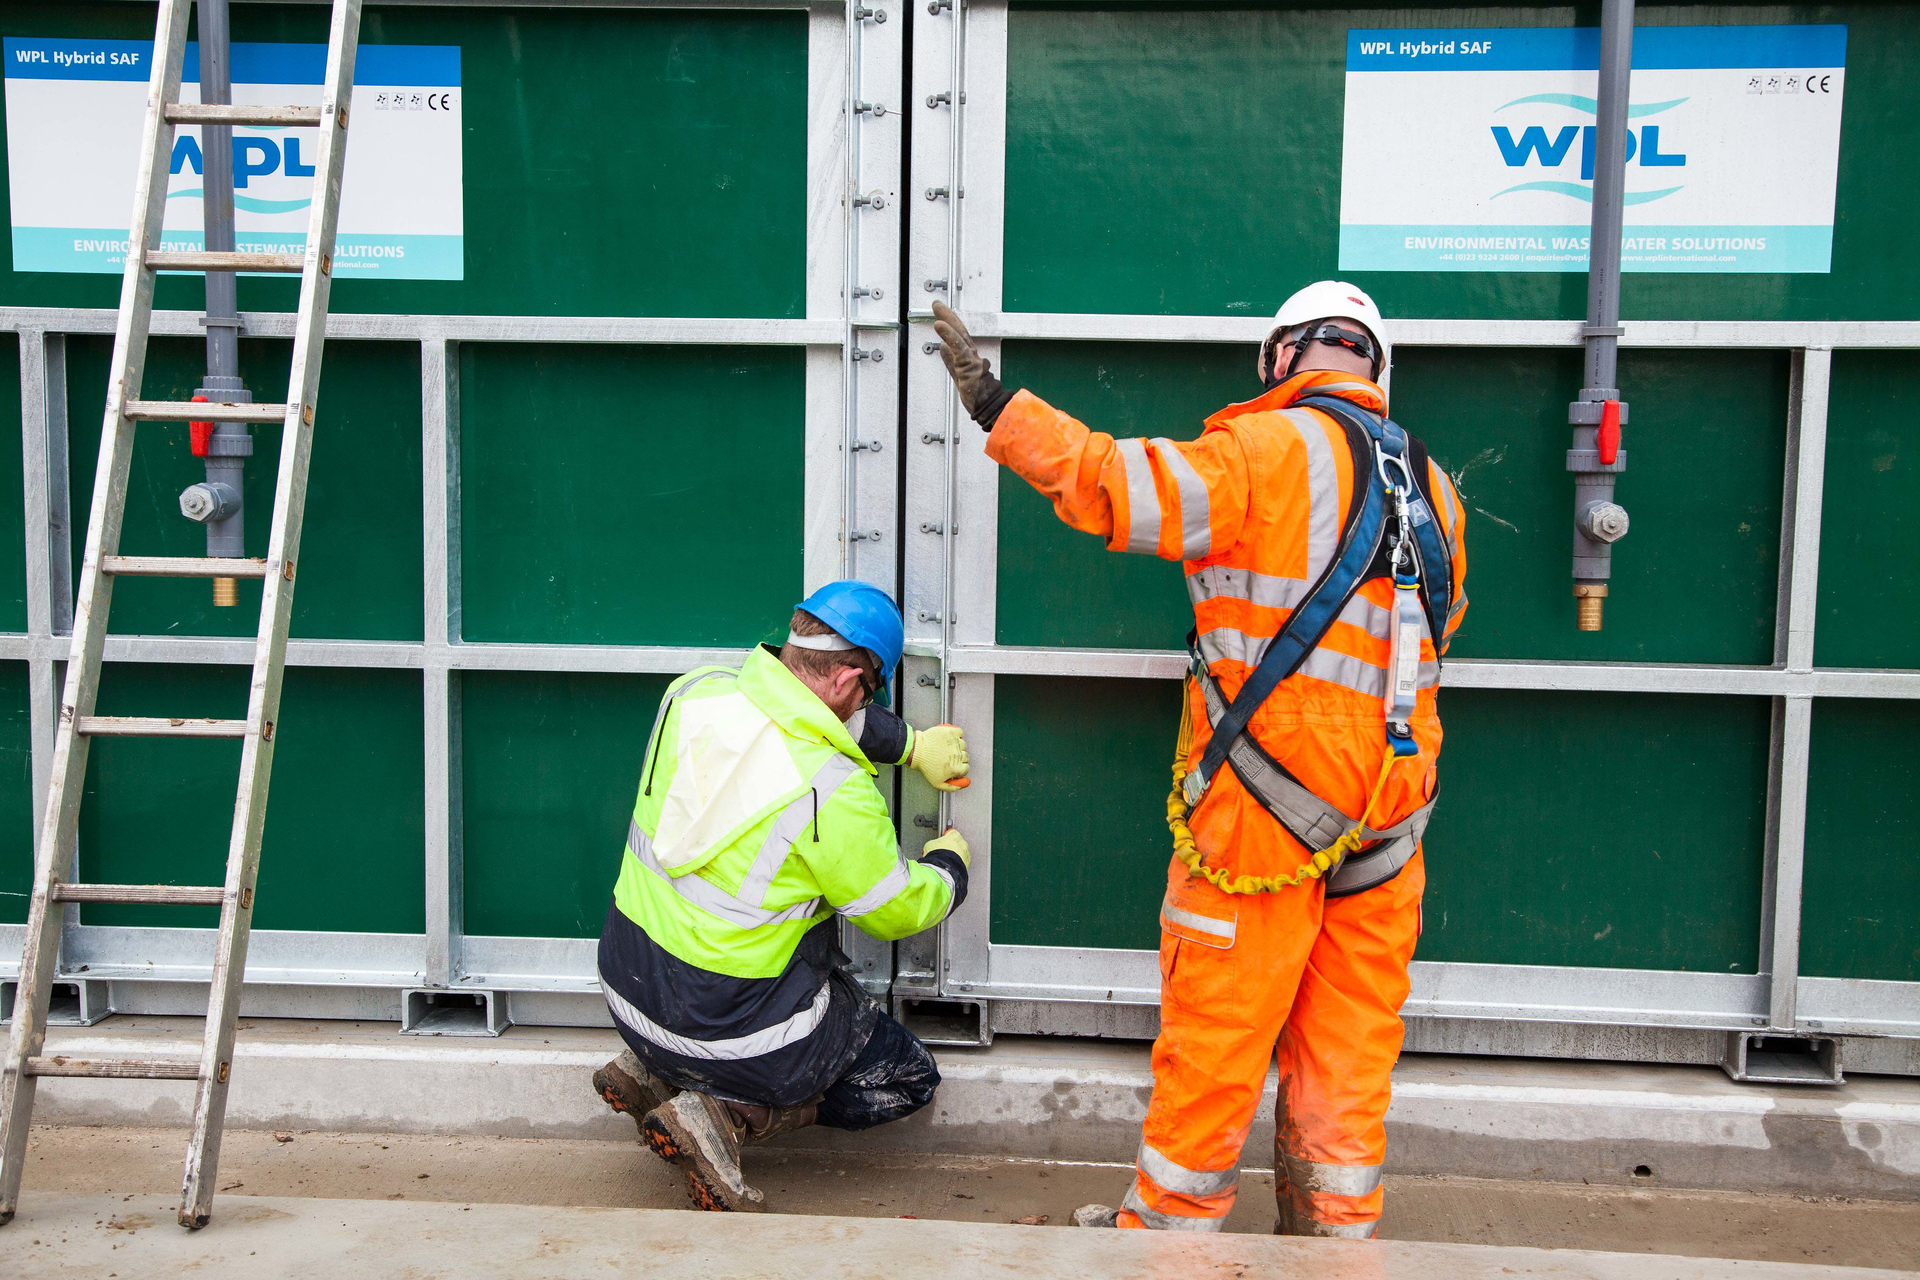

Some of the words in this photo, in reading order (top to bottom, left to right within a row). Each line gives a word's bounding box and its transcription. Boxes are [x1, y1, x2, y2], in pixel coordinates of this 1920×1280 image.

[1360, 42, 1395, 55] WPL
[1399, 41, 1455, 58] Hybrid
[1460, 41, 1492, 54] SAF
[16, 50, 49, 63] WPL
[53, 51, 106, 67] Hybrid
[110, 52, 140, 65] SAF
[1404, 237, 1547, 250] ENVIRONMENTAL
[1552, 237, 1667, 250] WASATER
[1671, 237, 1767, 250] SOLUTIONS
[1455, 253, 1476, 262] (0)23
[1525, 253, 1591, 263] enquiries@wpl.
